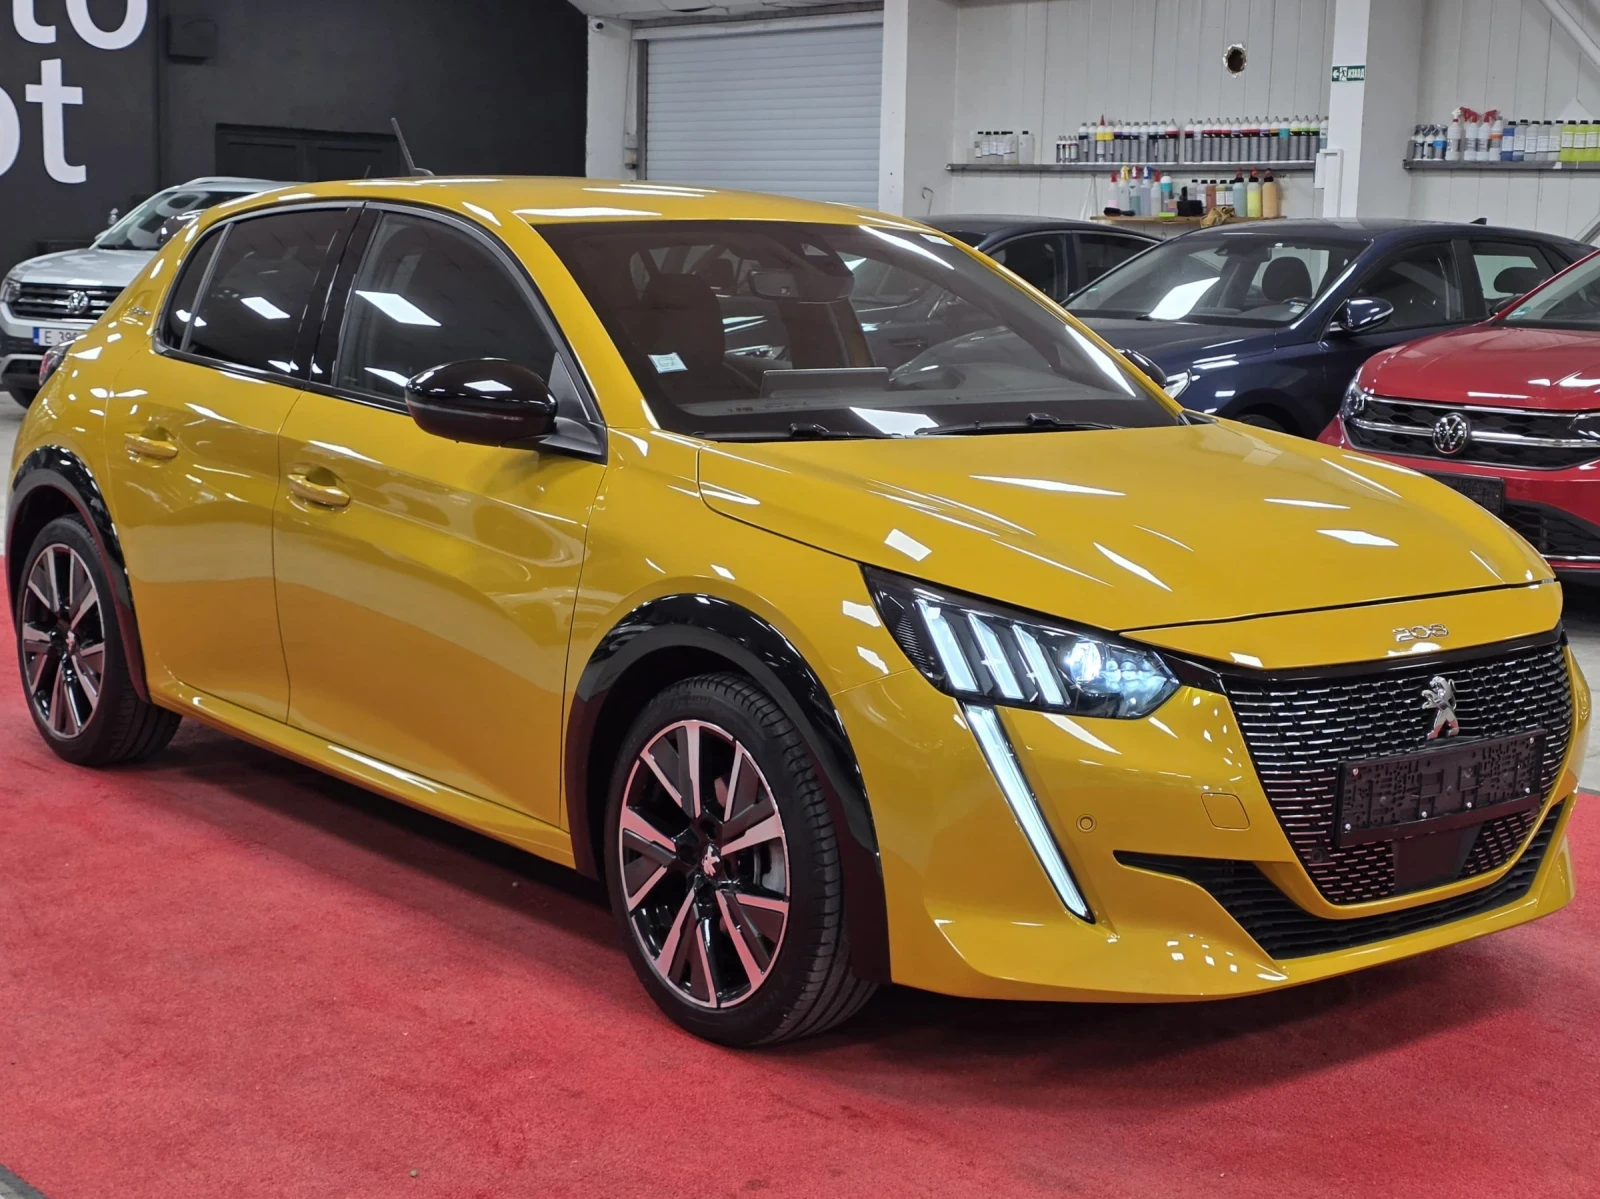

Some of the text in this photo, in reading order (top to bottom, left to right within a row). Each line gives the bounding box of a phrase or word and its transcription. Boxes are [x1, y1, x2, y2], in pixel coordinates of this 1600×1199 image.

[0, 58, 87, 184] t
[44, 330, 79, 345] E 39
[1392, 623, 1449, 642] 208
